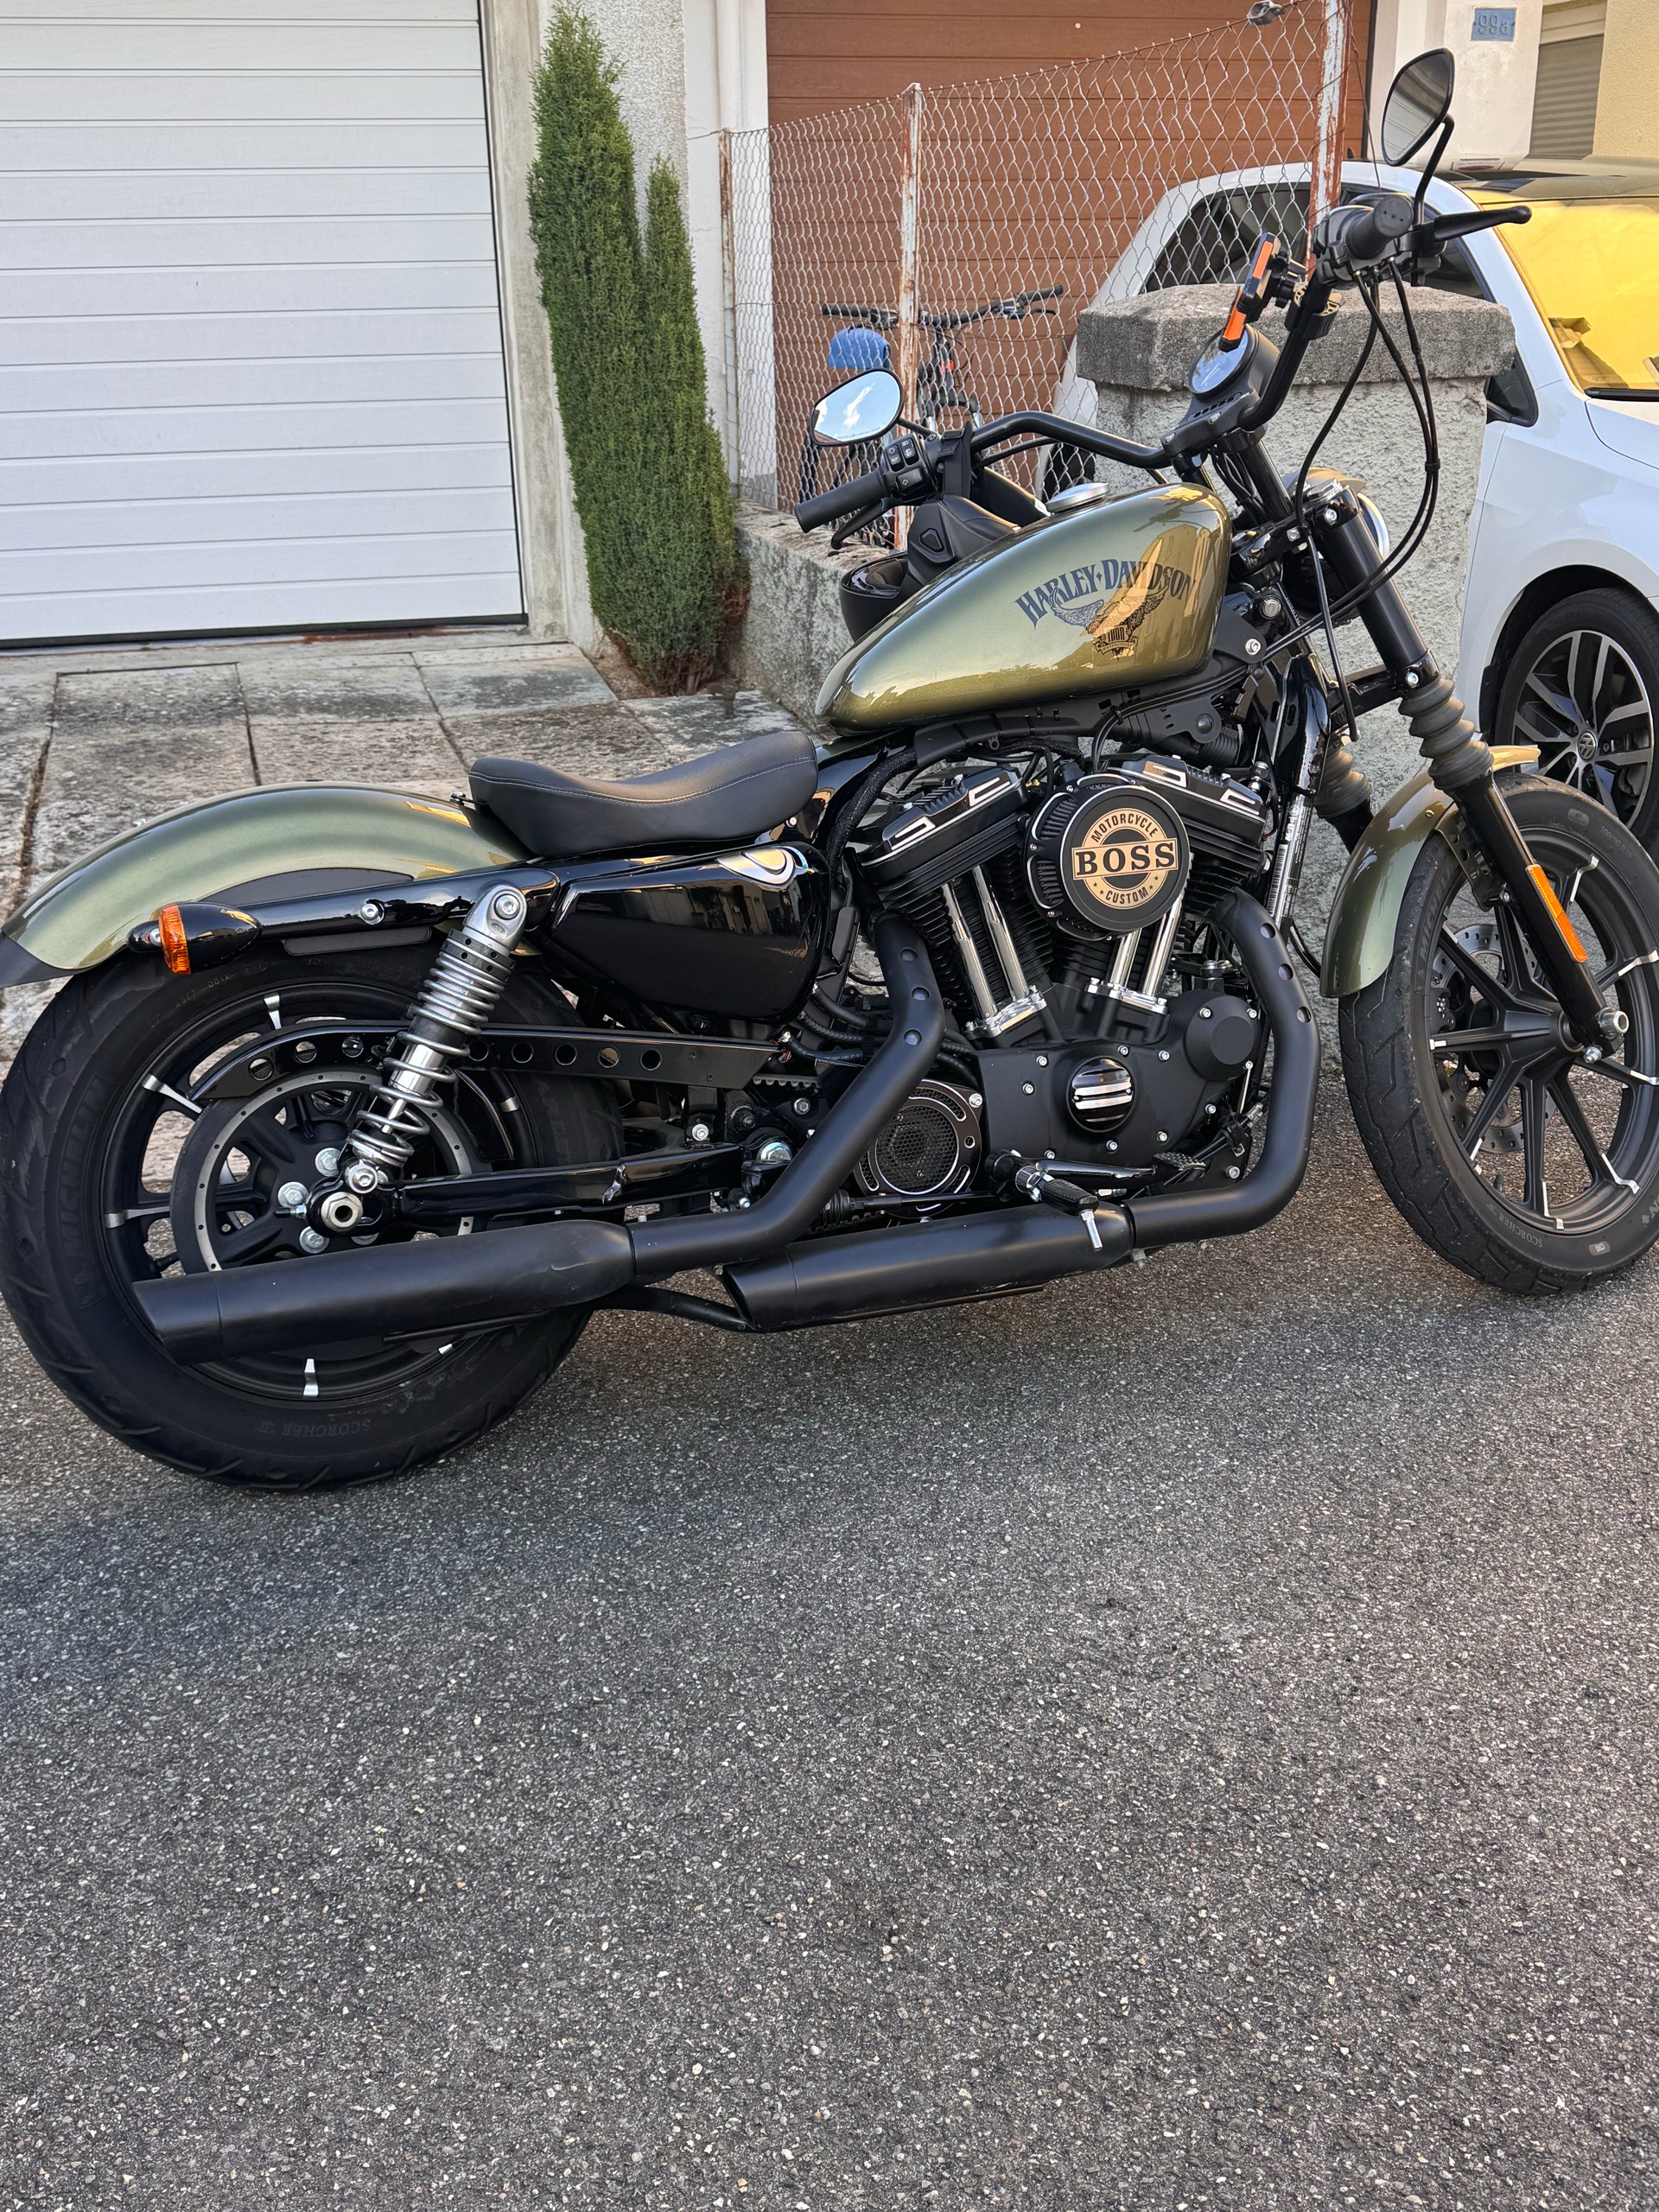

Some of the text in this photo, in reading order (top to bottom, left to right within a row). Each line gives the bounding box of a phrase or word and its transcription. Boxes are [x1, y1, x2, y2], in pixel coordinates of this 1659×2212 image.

[1478, 14, 1508, 35] 99a
[1090, 813, 1159, 842] MOTORCYCLE
[1075, 842, 1175, 875] BOSS
[1105, 887, 1149, 905] CUSTOM
[1497, 1211, 1543, 1249] SCORCHER
[281, 1418, 372, 1438] SCORCHER
